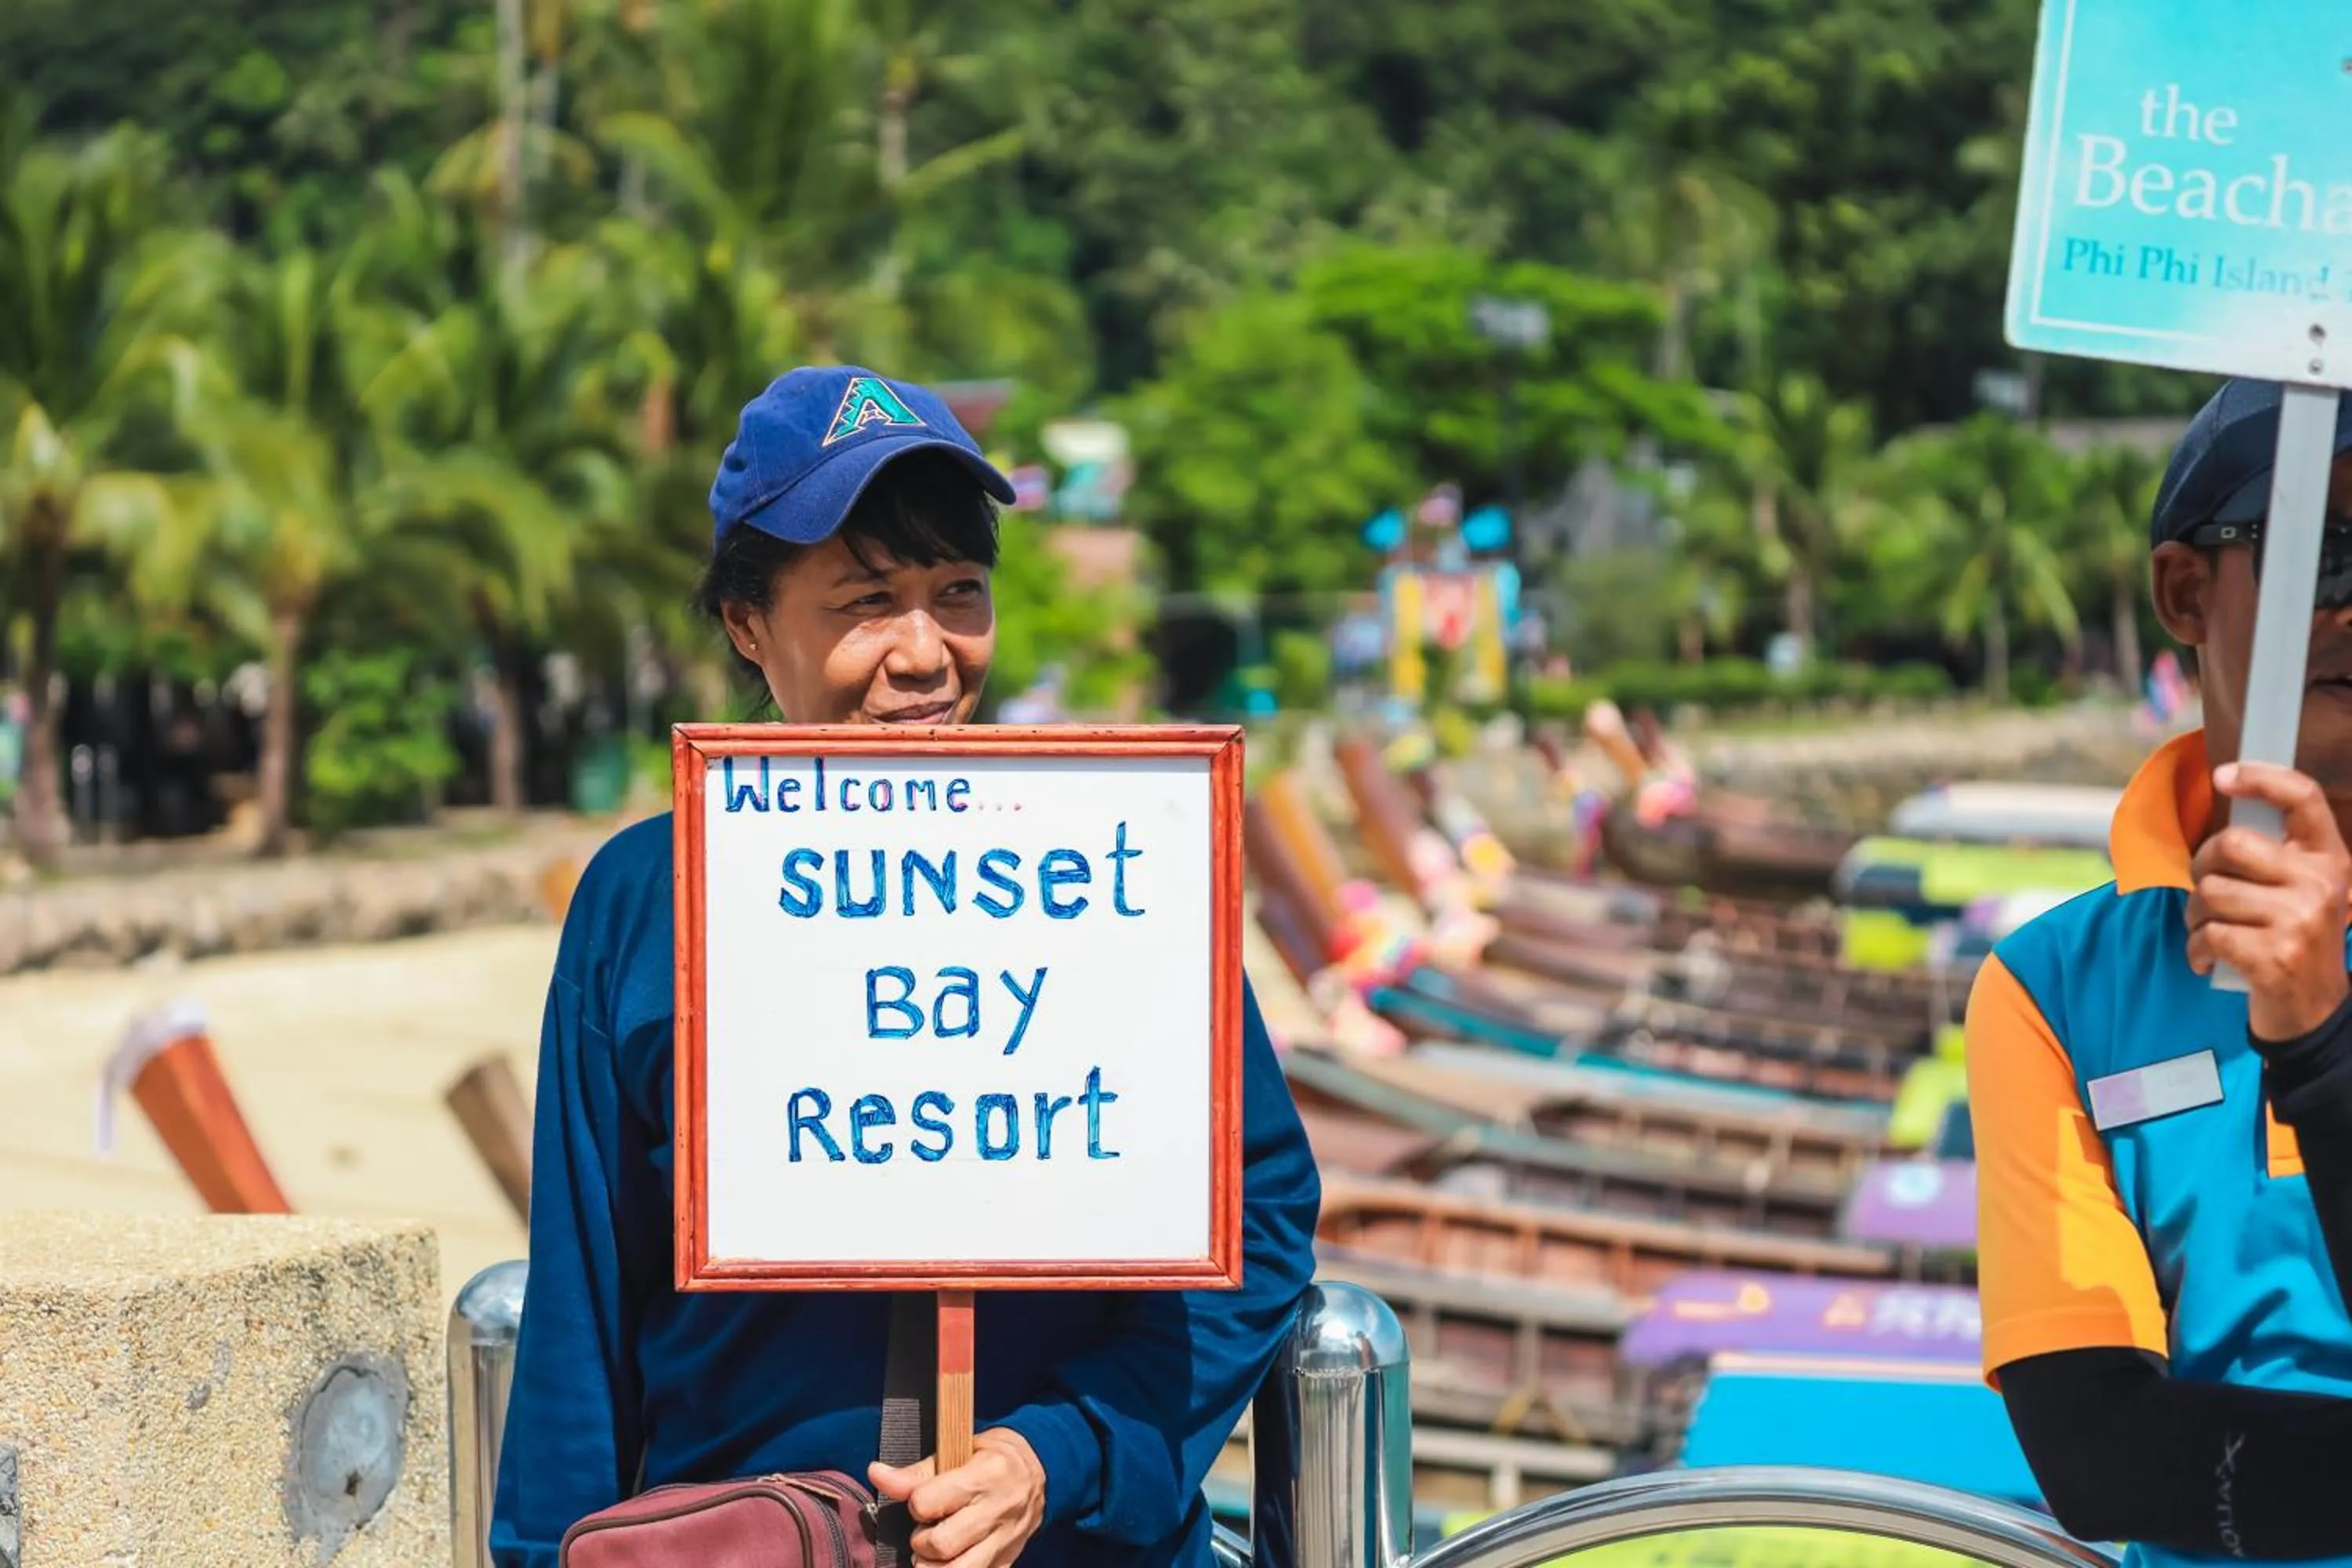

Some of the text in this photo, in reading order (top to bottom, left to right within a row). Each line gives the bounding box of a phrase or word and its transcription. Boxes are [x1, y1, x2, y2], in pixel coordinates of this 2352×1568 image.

[2140, 82, 2238, 145] the
[2063, 237, 2125, 276] Phi
[2137, 245, 2198, 285] Phi
[865, 965, 1048, 1055] Bay
[787, 1066, 1121, 1164] Resort
